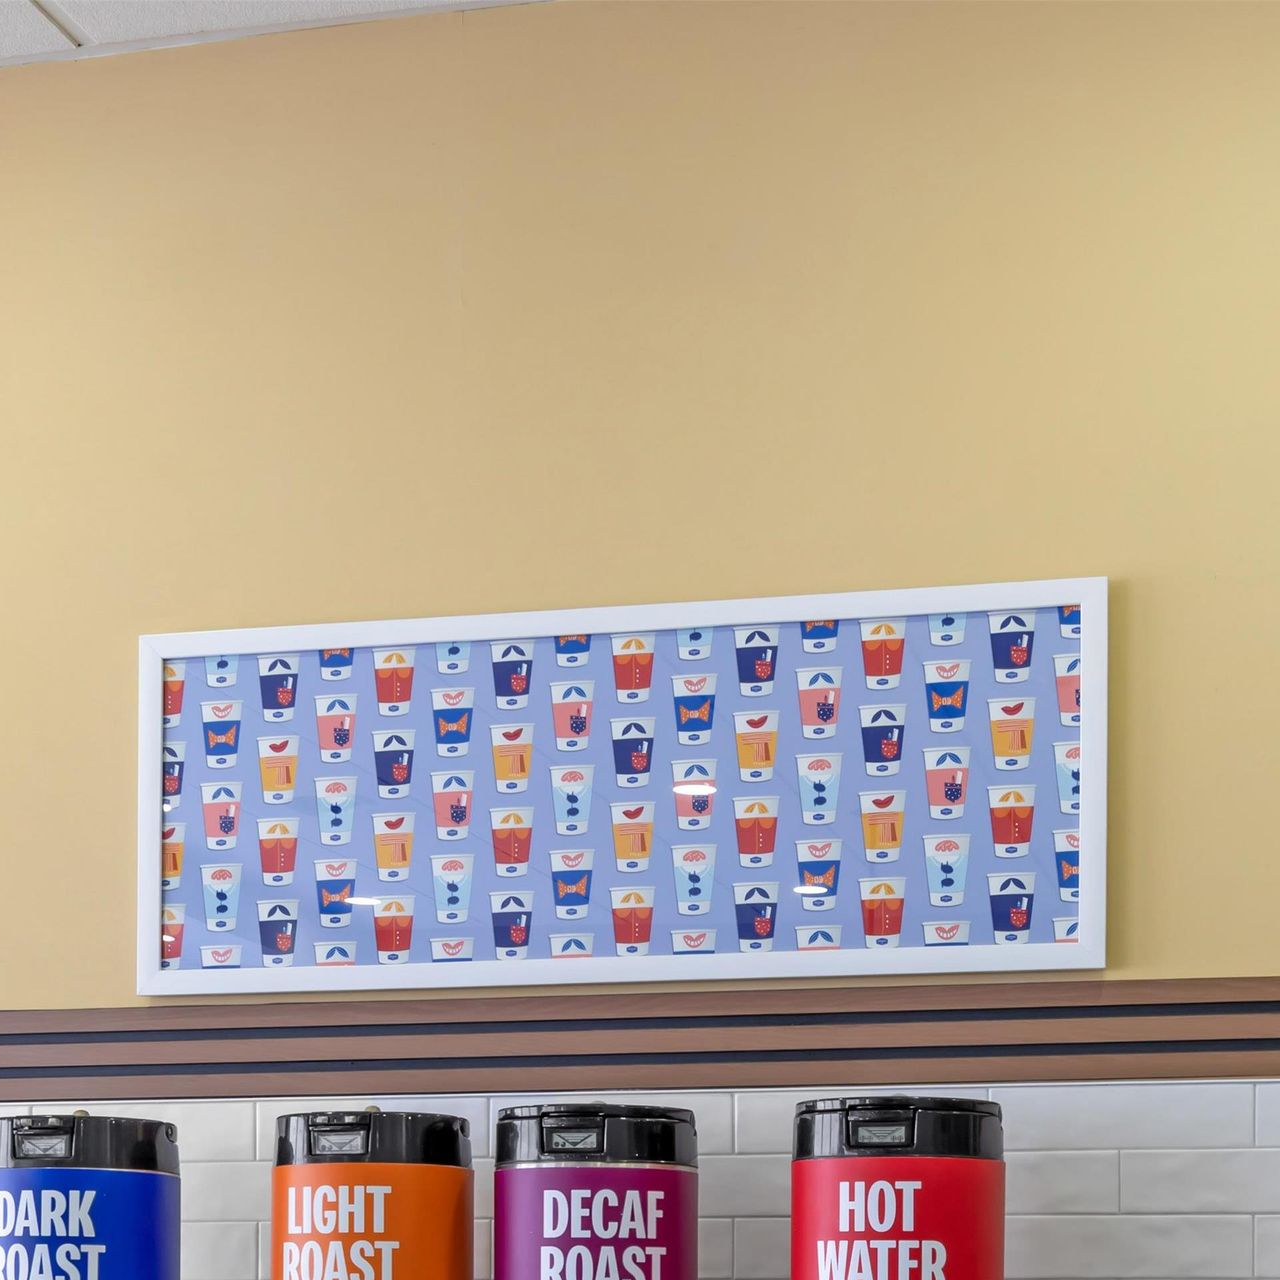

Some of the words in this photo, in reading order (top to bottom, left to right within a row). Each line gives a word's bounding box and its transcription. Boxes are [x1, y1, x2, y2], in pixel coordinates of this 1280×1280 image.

[288, 1185, 392, 1234] LIGHT
[543, 1189, 665, 1239] DECAF
[839, 1180, 922, 1232] HOT
